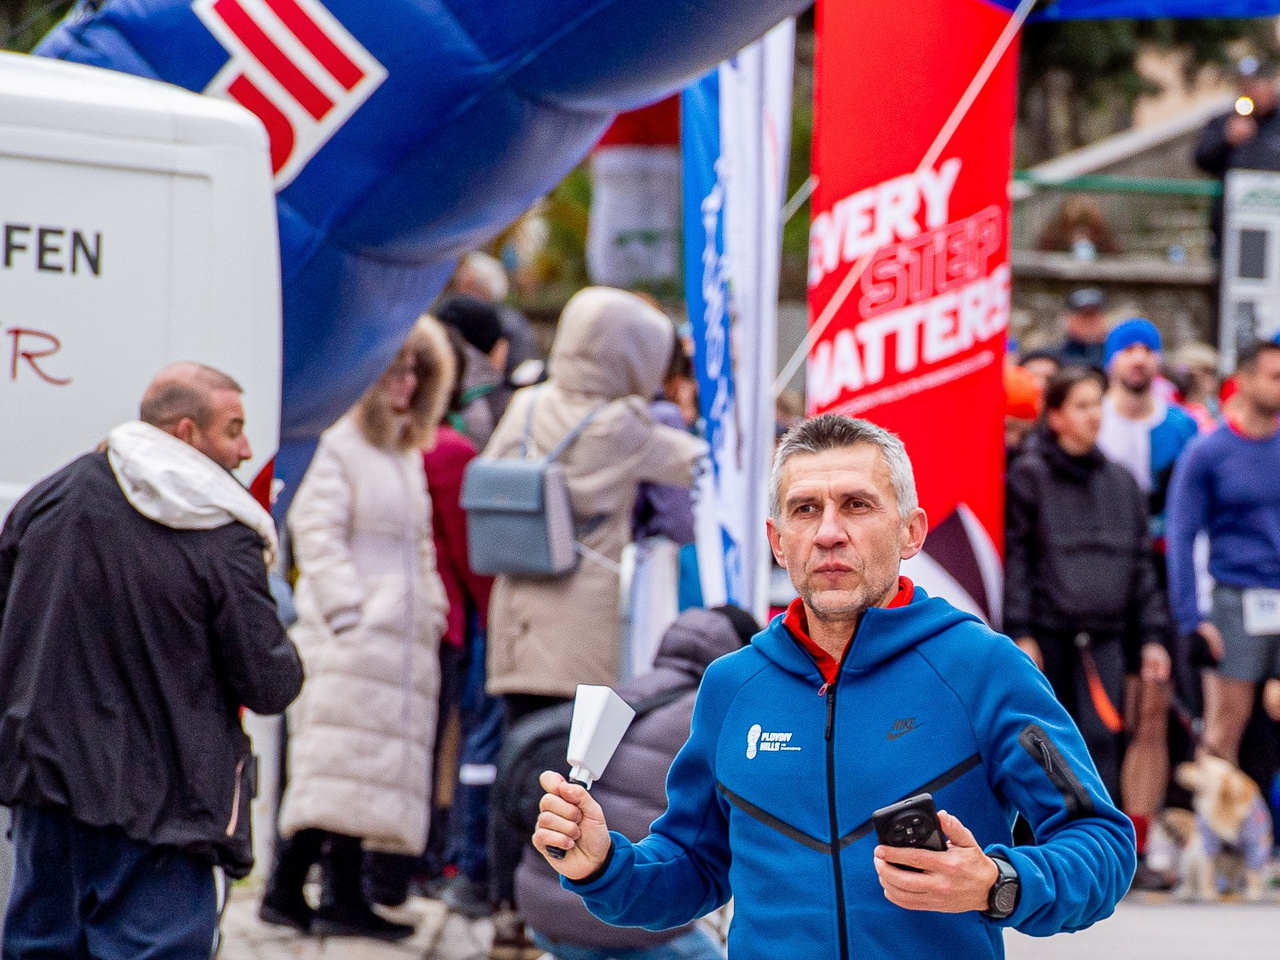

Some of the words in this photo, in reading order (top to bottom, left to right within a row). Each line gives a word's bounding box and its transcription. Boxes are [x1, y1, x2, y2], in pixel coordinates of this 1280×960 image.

[859, 206, 1002, 318] STEP
[5, 327, 73, 386] R
[760, 742, 780, 751] HILLS
[761, 732, 793, 742] PLOVDIV
